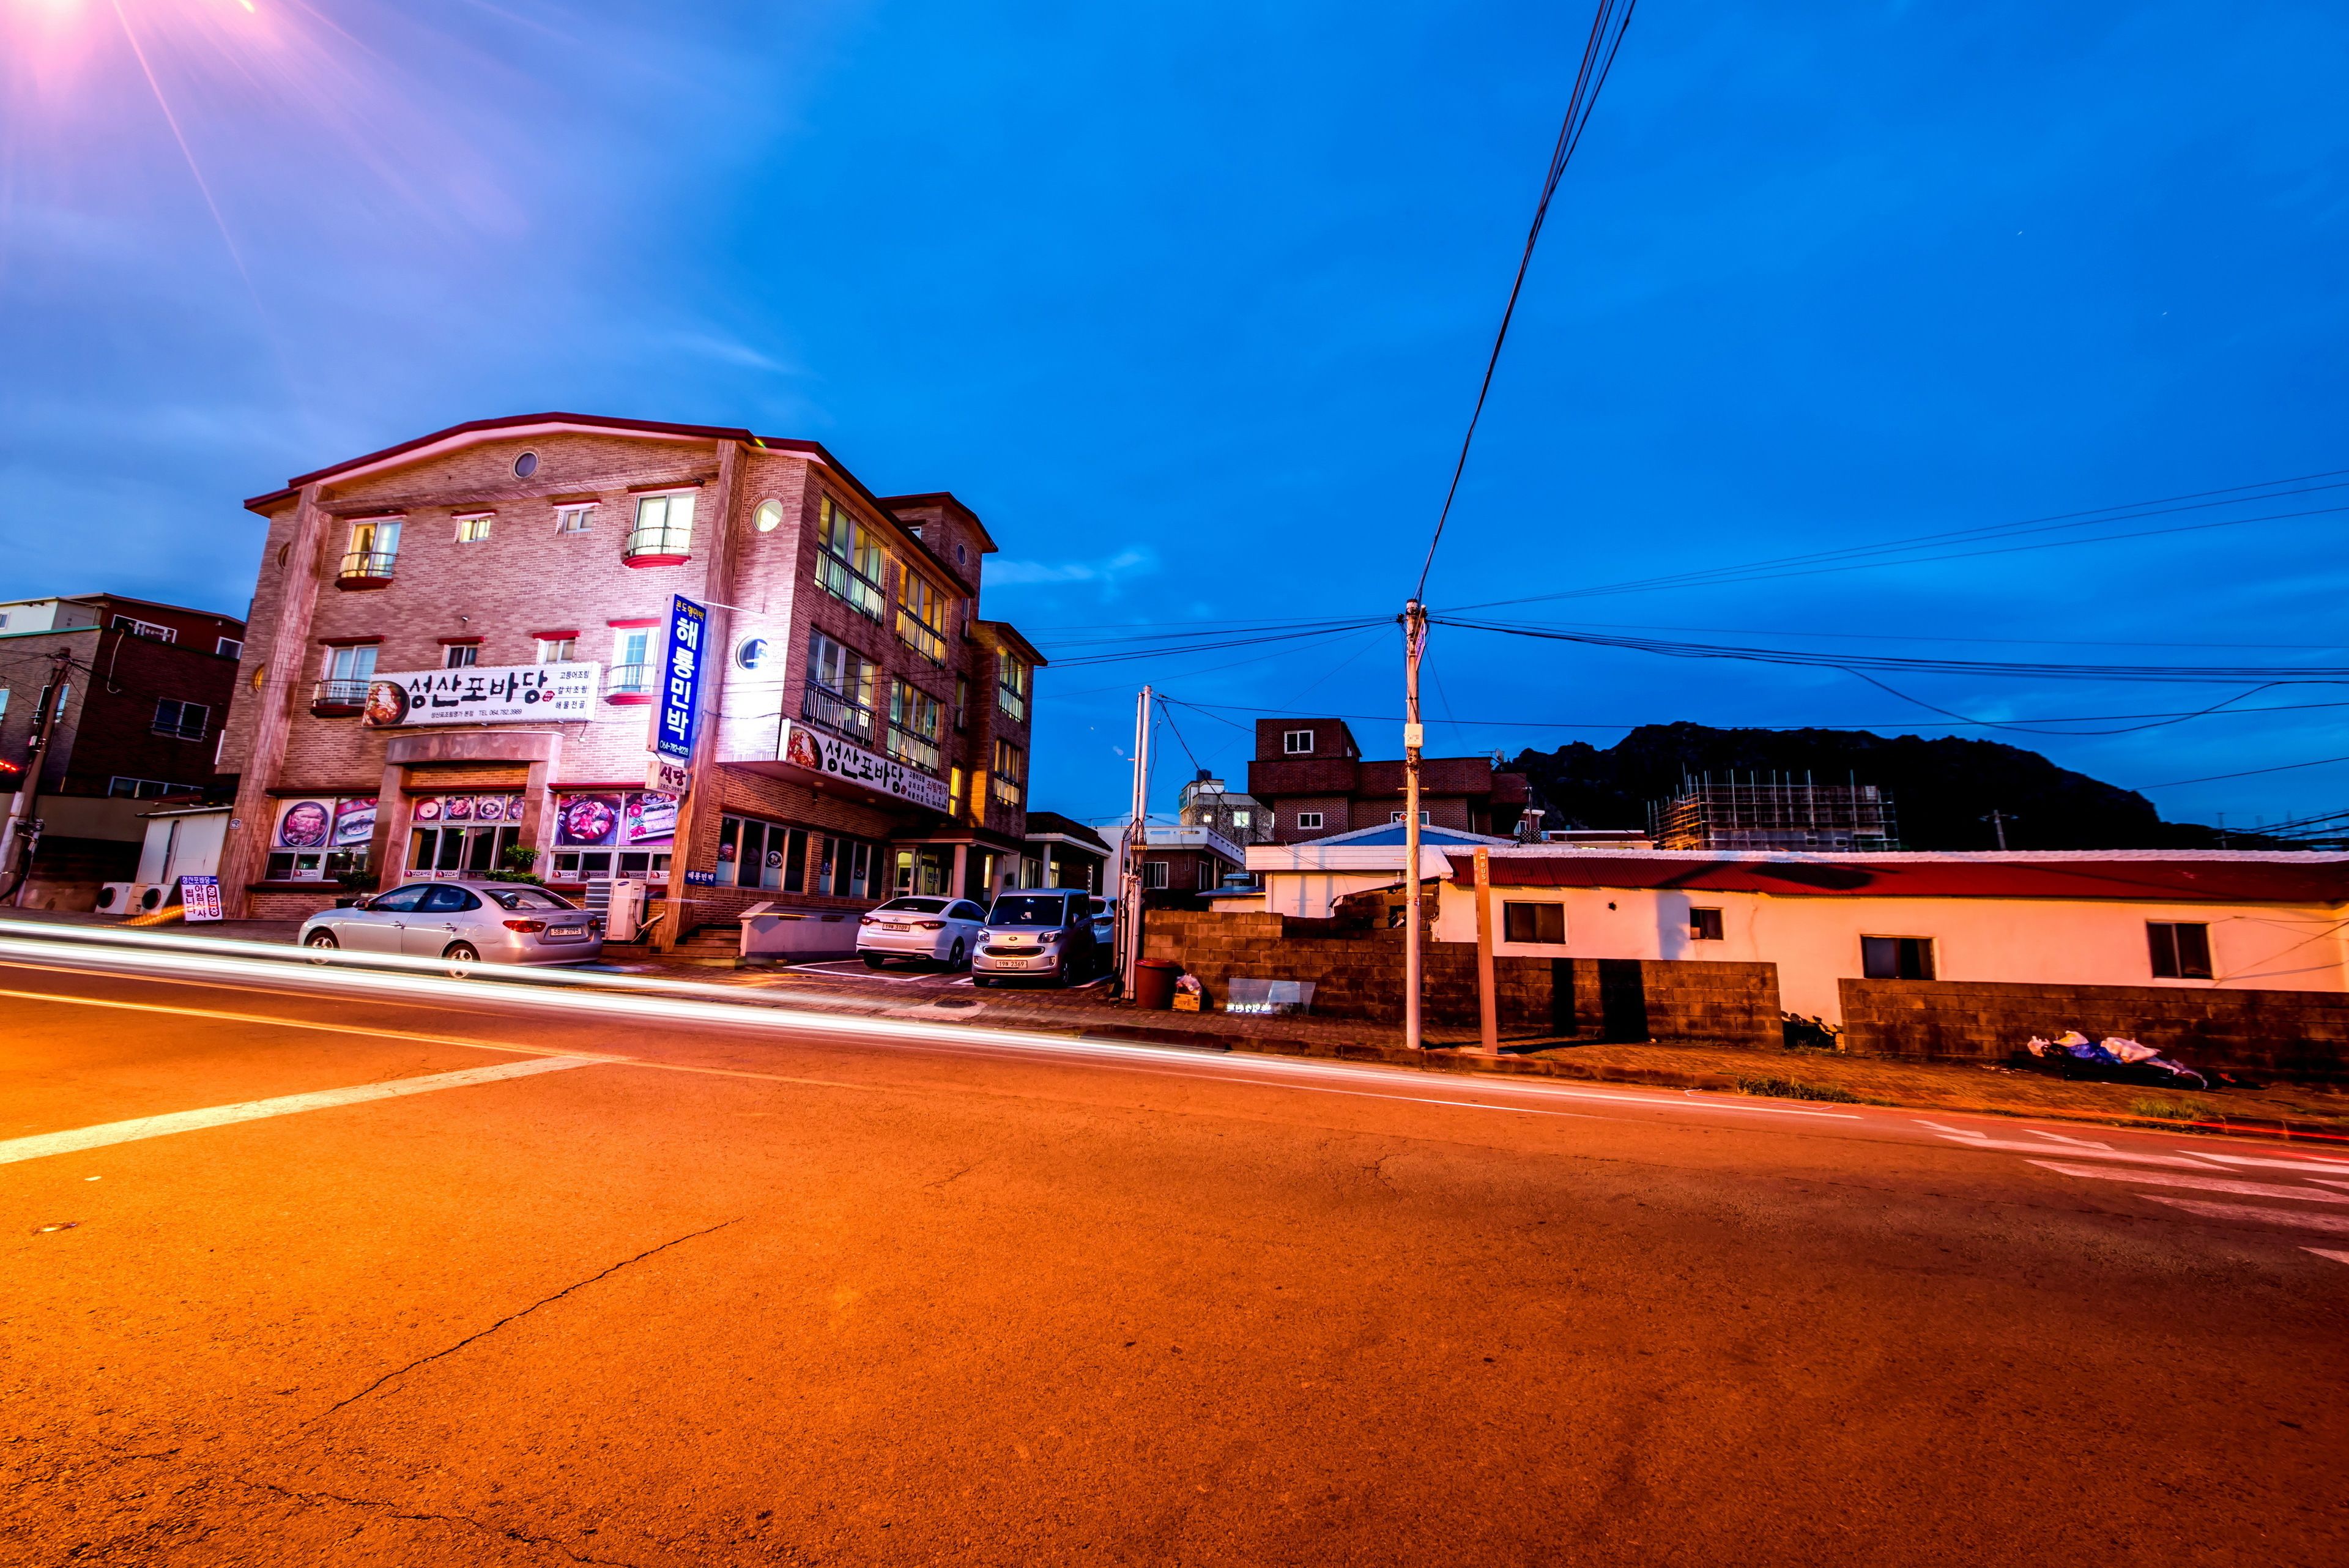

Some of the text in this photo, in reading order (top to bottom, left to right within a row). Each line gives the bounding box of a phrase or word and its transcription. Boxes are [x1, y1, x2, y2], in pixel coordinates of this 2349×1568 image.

[560, 671, 589, 679] 고등어조림
[666, 617, 699, 741] 해룡민박
[409, 670, 548, 708] 성산포바당
[558, 685, 587, 694] 갈치조림
[555, 700, 585, 709] 해물전골
[659, 765, 686, 787] 식당
[825, 740, 904, 793] 성산포바당
[659, 783, 683, 793] 782-3989
[207, 886, 218, 915] 영업중
